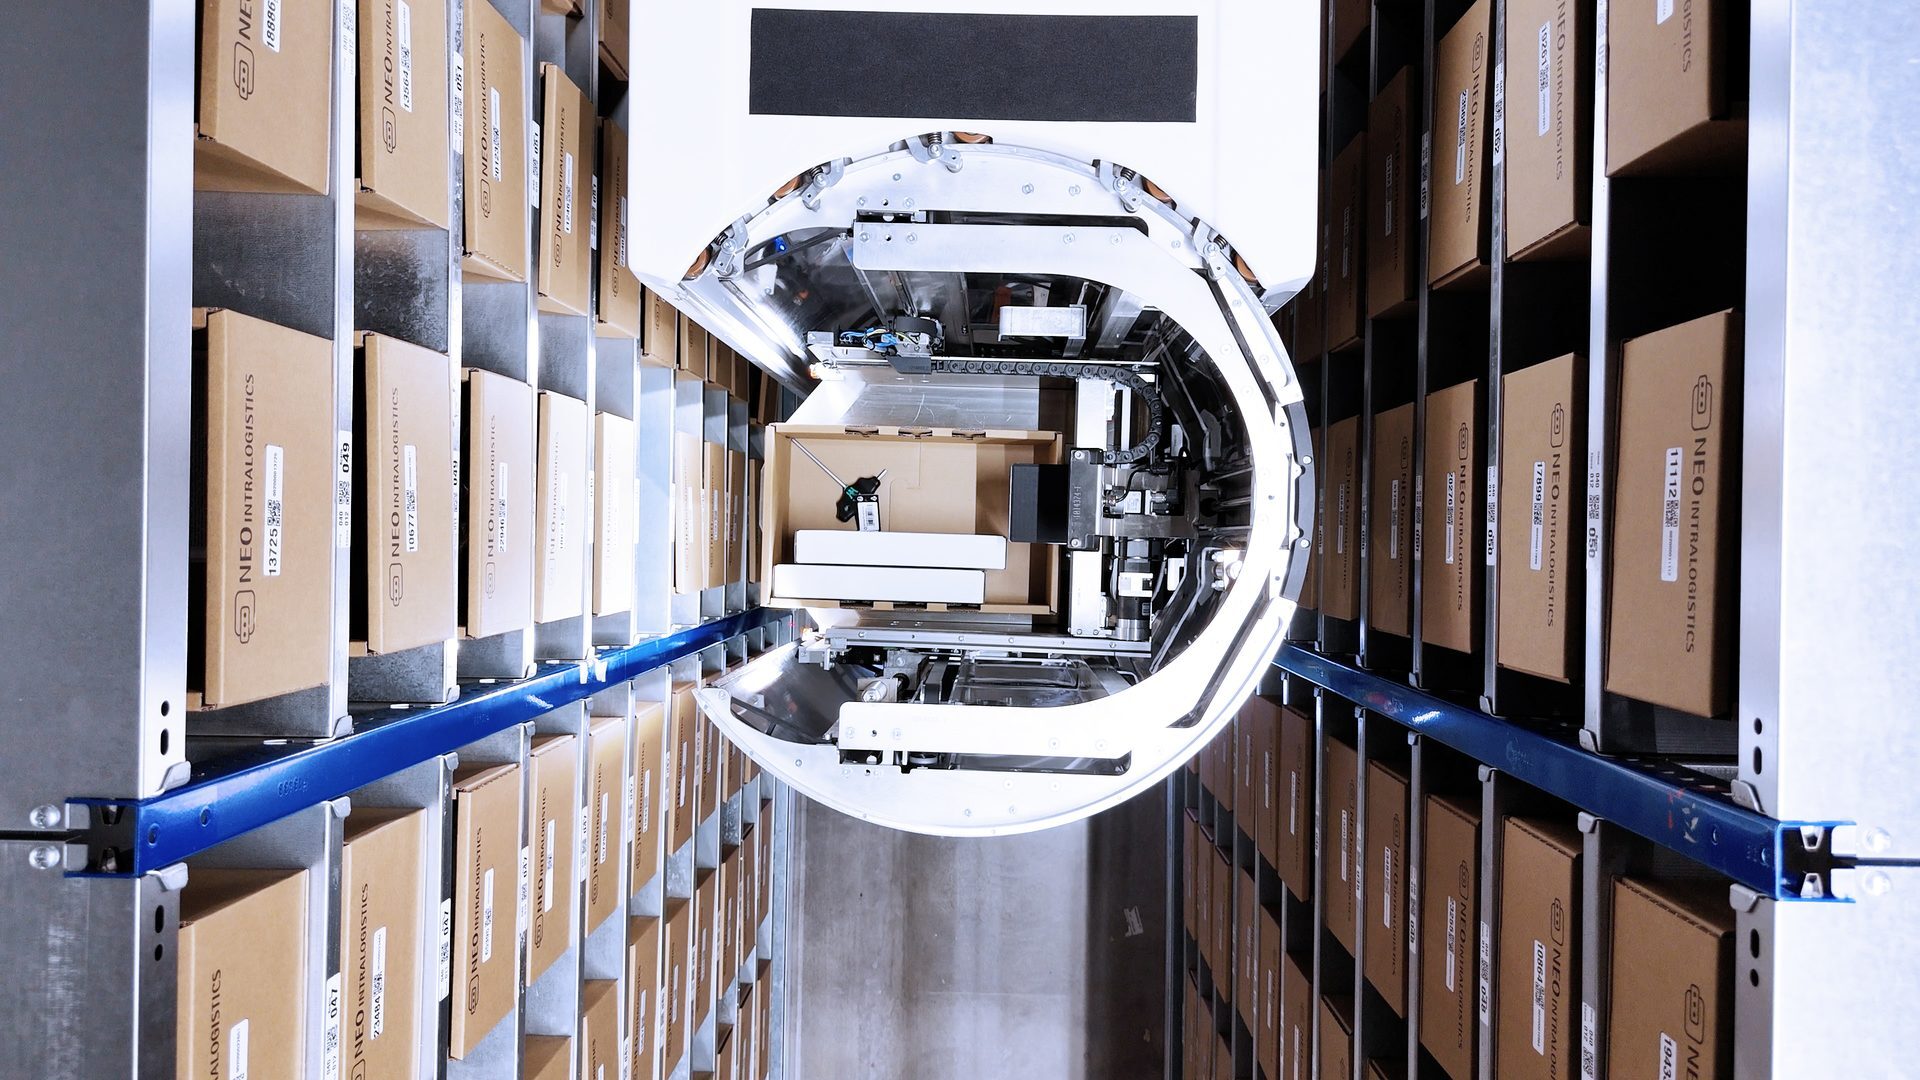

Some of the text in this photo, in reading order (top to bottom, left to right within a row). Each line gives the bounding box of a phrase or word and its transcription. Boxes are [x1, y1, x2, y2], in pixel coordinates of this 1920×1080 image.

[238, 0, 252, 41] NE
[383, 0, 393, 105] NEO INTRAL
[1597, 43, 1606, 77] 052
[402, 70, 410, 109] 13564
[1555, 3, 1566, 180] NEO INTRALOGISTICS
[1466, 74, 1480, 223] NEO INTRALOGISTICS
[238, 374, 255, 583] NEO INTRALOGISTICS
[342, 442, 350, 473] 049
[391, 387, 400, 557] NEO INTRALOGISTICS
[1668, 449, 1679, 498] 11112
[486, 414, 496, 557] NEO INTRALOGISTICS
[1459, 464, 1467, 504] NEO
[1535, 462, 1544, 502] 17899
[267, 528, 278, 576] 13725
[407, 513, 415, 552] 10677
[1547, 453, 1561, 627] NEO INTRALOGISTICS
[1588, 527, 1596, 559] 050
[1686, 437, 1707, 653] NEO INTRALOGISTICS
[1392, 850, 1400, 885] NEO
[471, 827, 482, 973] NEO INTRALOGISTICS
[1459, 901, 1467, 943] NEO
[354, 883, 368, 1058] NEO INTRALOGISTICS
[1552, 948, 1561, 998] NEO
[210, 969, 221, 1080] ALOGISTICS
[330, 988, 338, 1019] 047
[373, 995, 382, 1038] 23484
[1663, 1038, 1673, 1080] 1943
